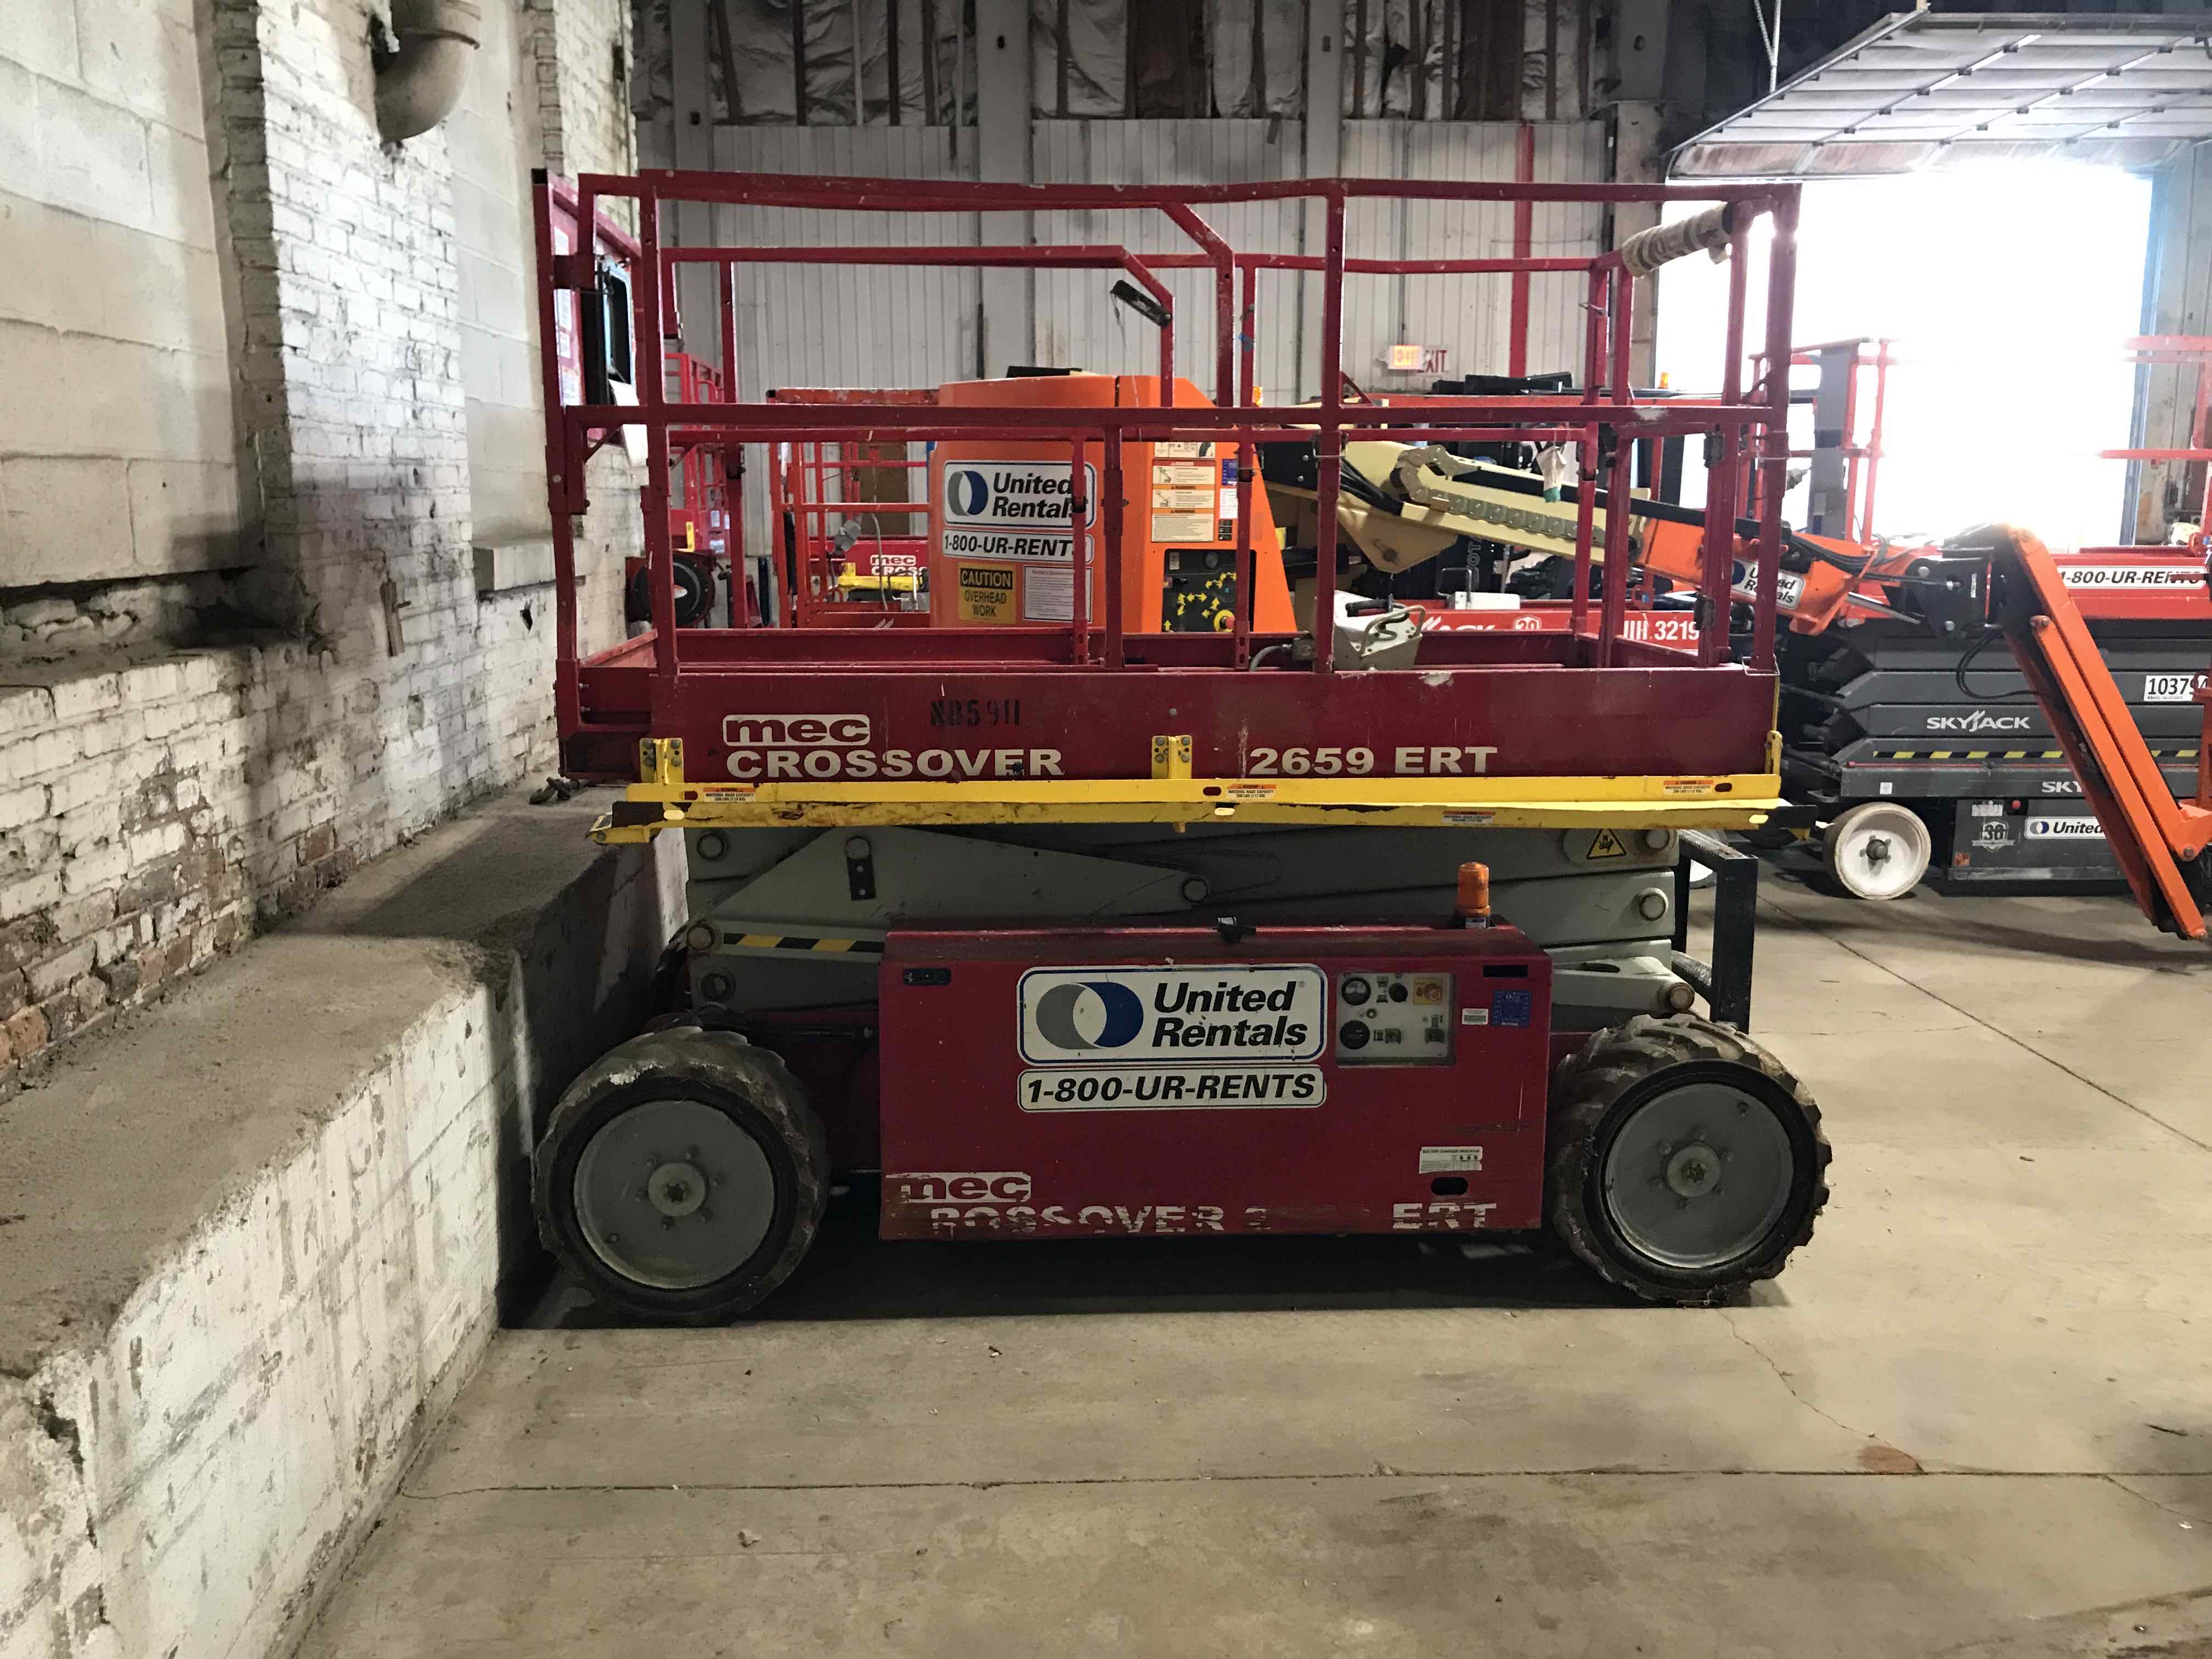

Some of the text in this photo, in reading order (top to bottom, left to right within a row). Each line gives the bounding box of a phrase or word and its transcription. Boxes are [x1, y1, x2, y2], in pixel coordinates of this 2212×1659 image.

[992, 496, 1072, 518] Rental
[945, 534, 1074, 556] 1-800-UR-RENT
[871, 556, 916, 565] mec
[961, 569, 1011, 587] CAUTION
[1750, 567, 1796, 590] Ued
[965, 590, 1007, 604] OVERHEAD
[1744, 579, 1795, 603] Rals
[972, 605, 996, 617] WORK
[726, 719, 869, 743] mec
[1927, 710, 2030, 732] SKYJACK
[726, 746, 1498, 778] CROSSOVER 2659 ERT
[1154, 981, 1297, 1013] United
[1152, 1015, 1308, 1047] Rentals
[1028, 1073, 1316, 1103] 1-800-UR-RENTS
[1392, 1203, 1497, 1229] ERT
